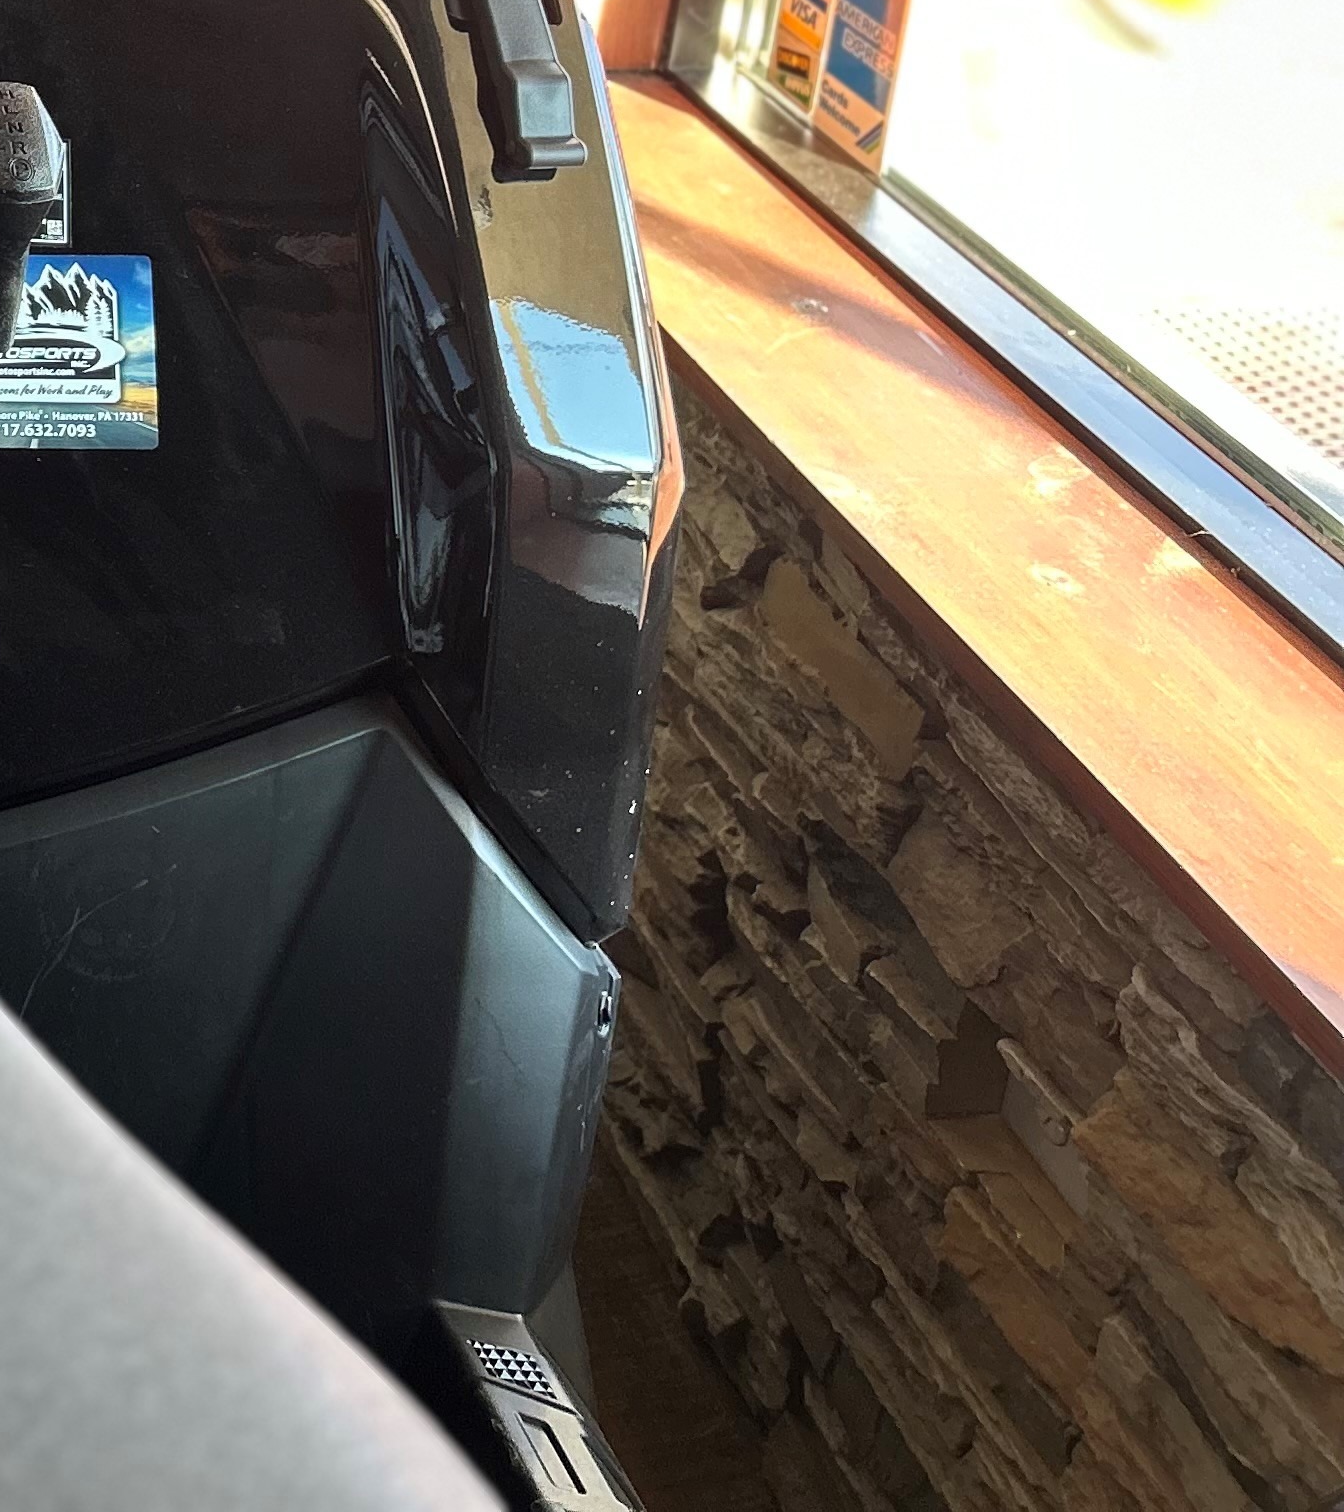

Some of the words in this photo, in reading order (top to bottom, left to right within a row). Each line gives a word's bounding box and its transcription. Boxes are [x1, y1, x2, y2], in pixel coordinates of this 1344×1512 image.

[843, 31, 894, 79] EXPRESS
[821, 79, 849, 109] Cards
[1, 104, 20, 115] L
[818, 94, 861, 137] Welcome
[5, 121, 24, 134] N
[10, 141, 28, 155] R
[13, 161, 29, 177] P
[19, 384, 36, 396] for
[37, 384, 63, 395] Work
[65, 385, 88, 395] and
[88, 385, 113, 399] Play
[18, 410, 41, 420] Pike
[51, 411, 96, 421] Hanover,
[97, 411, 112, 421] PA
[112, 411, 144, 422] 17331
